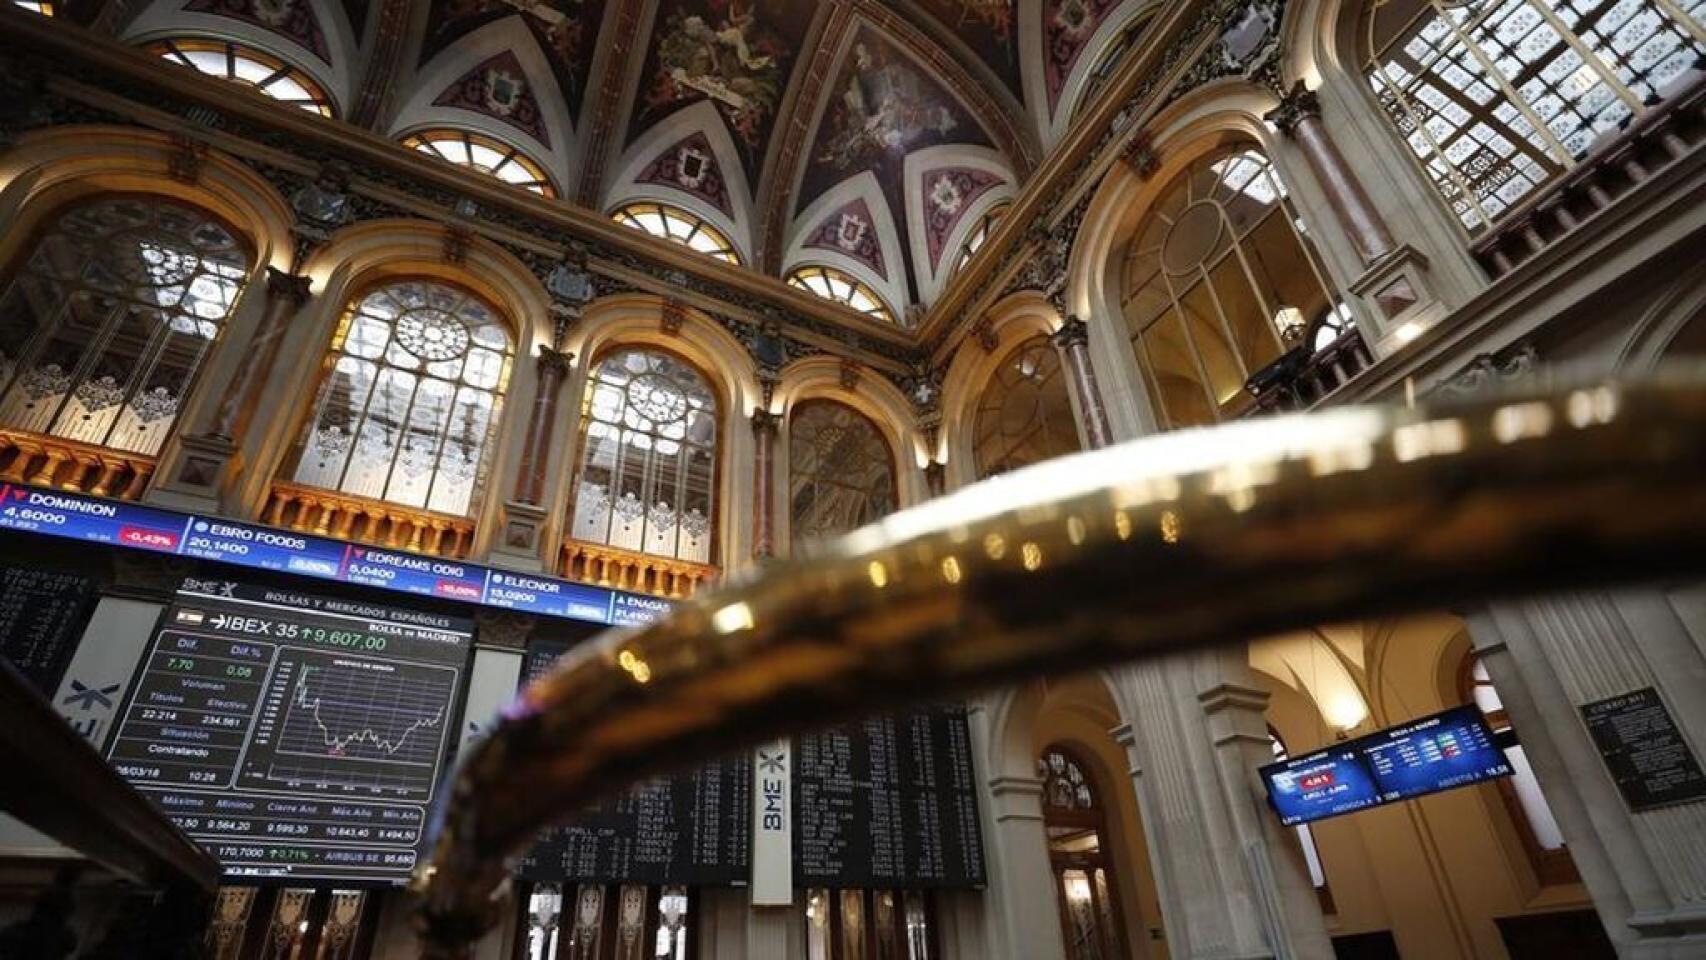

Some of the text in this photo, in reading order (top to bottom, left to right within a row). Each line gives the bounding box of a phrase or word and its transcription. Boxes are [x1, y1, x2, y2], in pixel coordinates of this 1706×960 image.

[29, 493, 116, 517] DOMINION
[4, 507, 66, 524] 4,6000
[188, 536, 249, 555] 20,1400
[210, 524, 306, 550] EBRO FOODS
[366, 551, 431, 572] EDREAMS
[182, 577, 219, 593] BME
[504, 575, 560, 593] ELECNOR
[264, 591, 450, 628] BOLSAS Y MERCADOS ESPAÑOLES
[225, 615, 272, 634] IBEX
[275, 624, 299, 639] 35
[369, 623, 402, 636] BOLSA
[417, 631, 460, 644] MADRID
[182, 679, 226, 691] Volumen
[148, 744, 209, 757] Contratando
[764, 778, 781, 831] BME
[324, 851, 363, 862] AIRBUS
